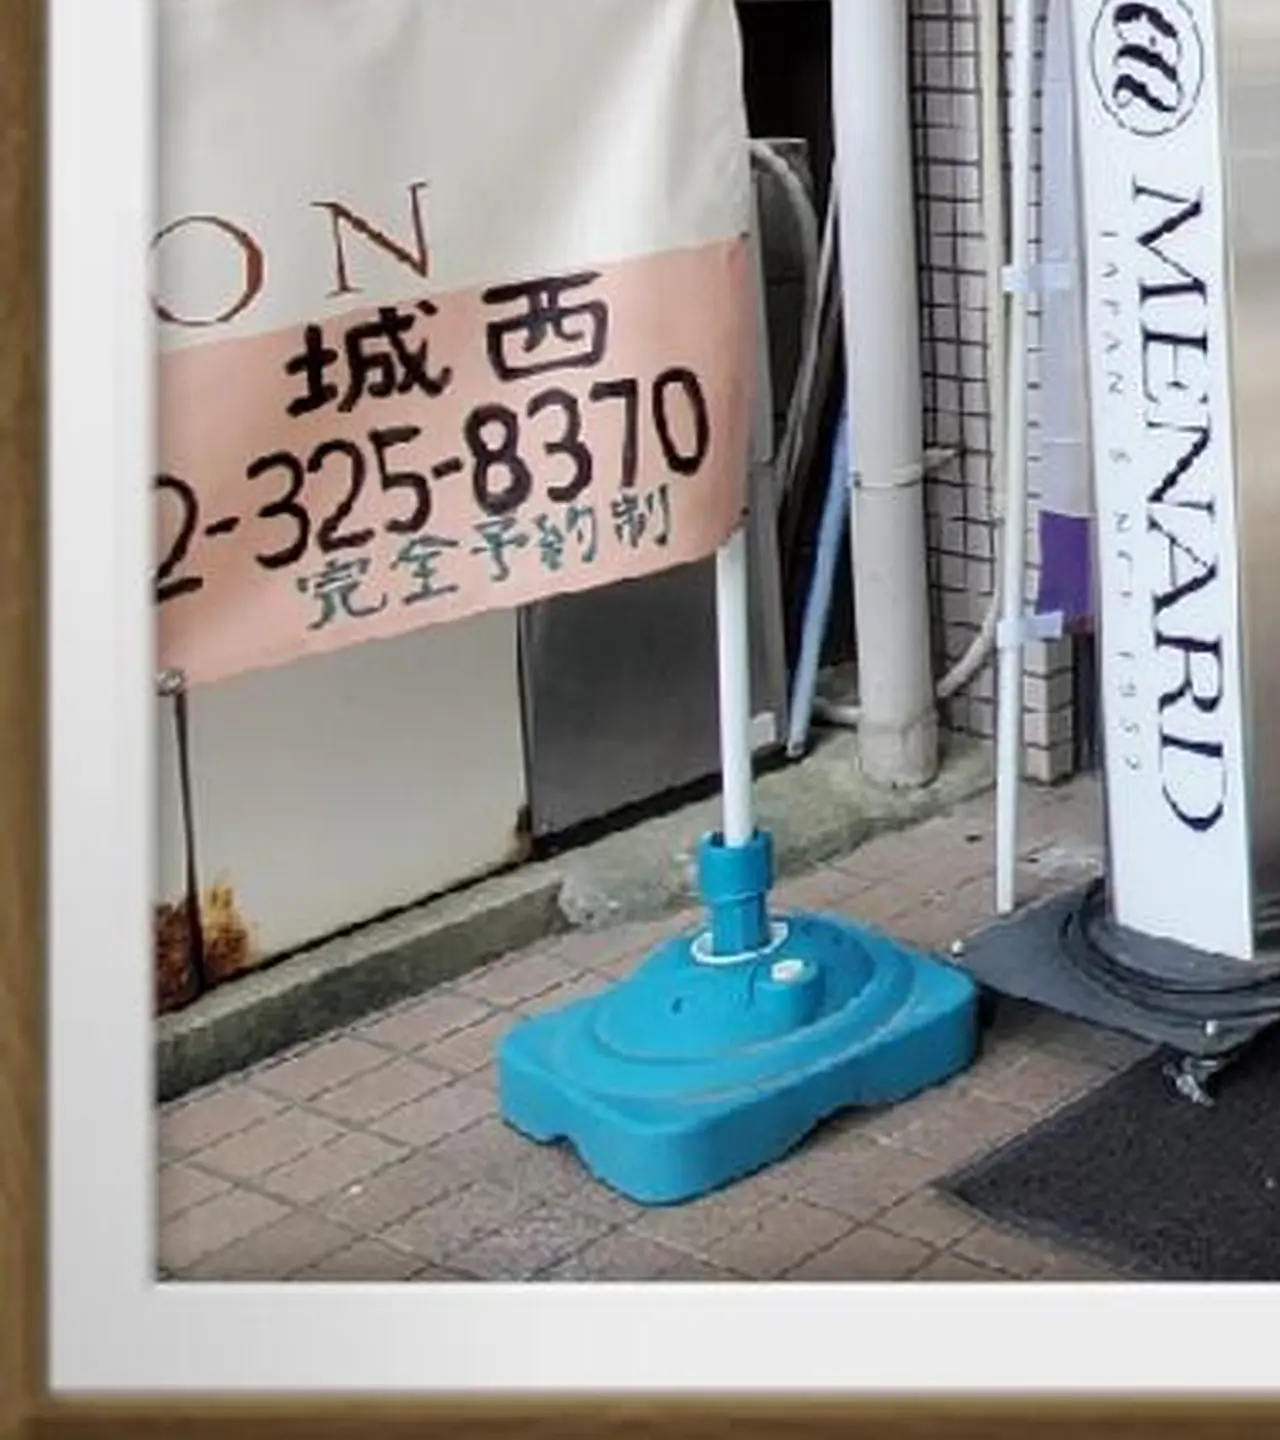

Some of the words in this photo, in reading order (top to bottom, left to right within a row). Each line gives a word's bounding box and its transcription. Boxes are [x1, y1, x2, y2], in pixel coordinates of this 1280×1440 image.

[284, 271, 612, 420] 城西
[153, 366, 711, 604] 2-325-8370
[293, 482, 673, 632] 完全予約制
[1132, 173, 1227, 833] MENARD
